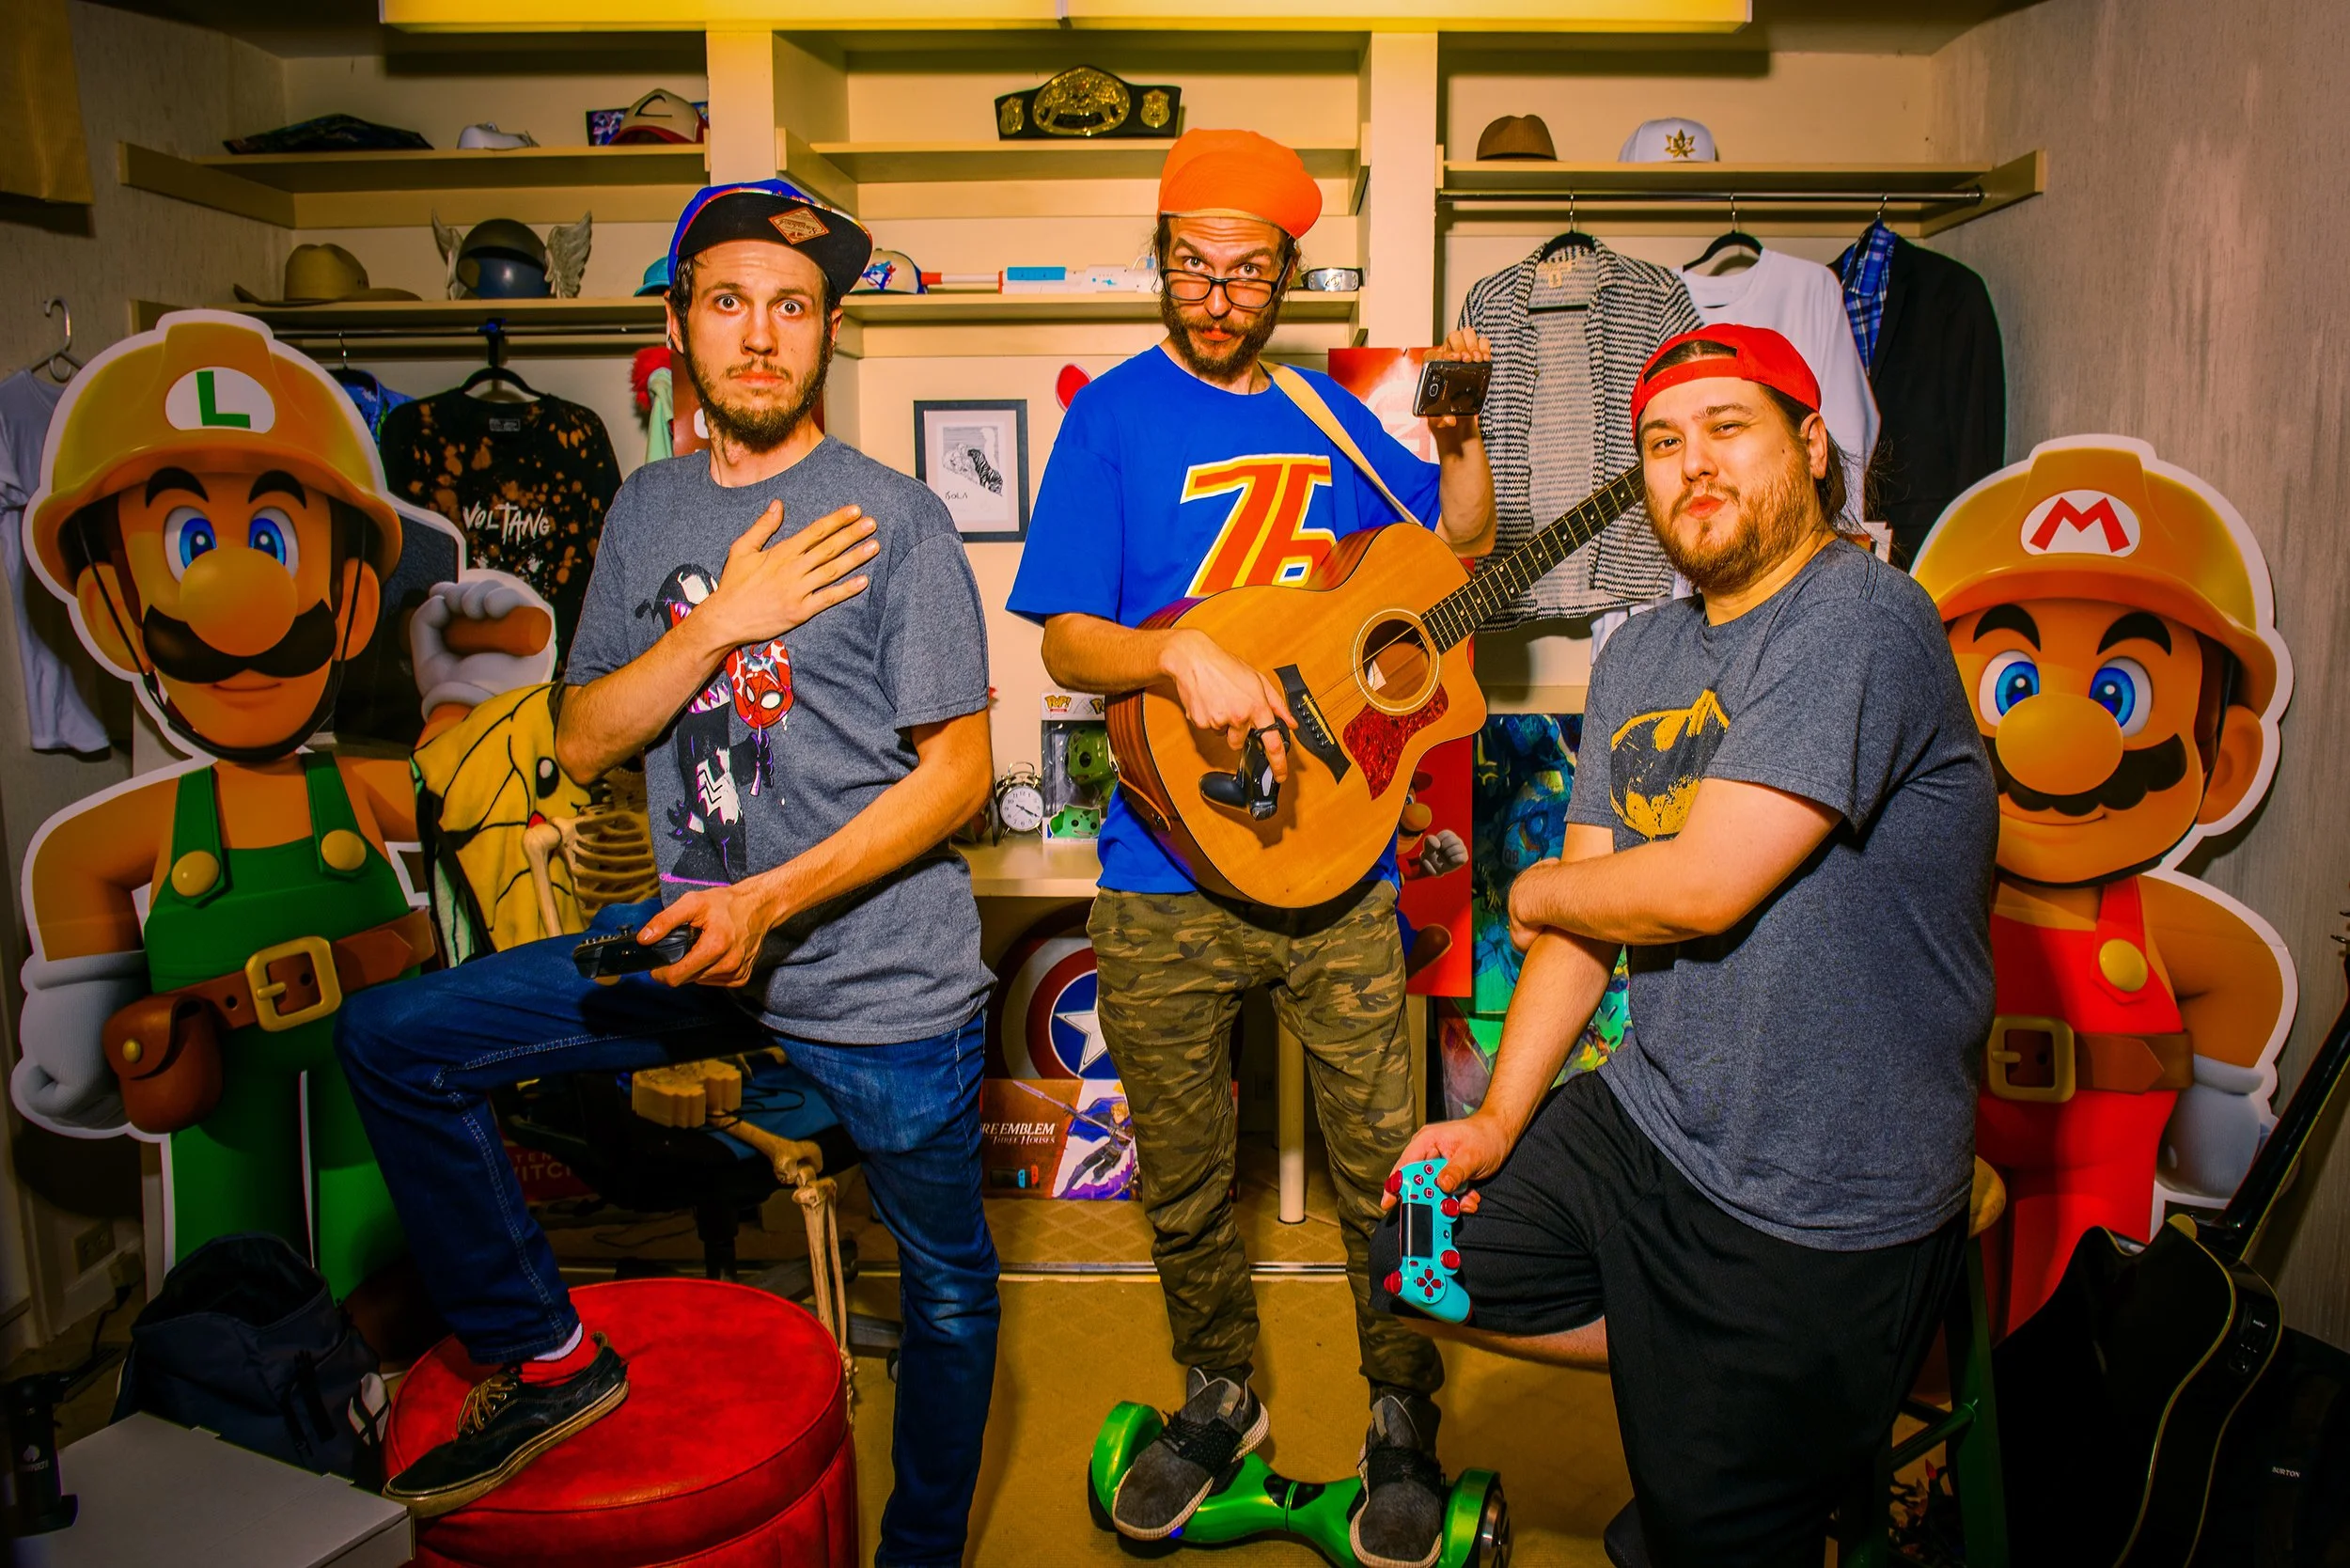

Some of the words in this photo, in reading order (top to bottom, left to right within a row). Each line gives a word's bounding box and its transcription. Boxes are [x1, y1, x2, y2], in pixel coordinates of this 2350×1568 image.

[196, 370, 251, 430] L
[462, 500, 551, 545] VOLTANG
[1180, 453, 1337, 598] 76
[2029, 496, 2131, 554] M
[1000, 1122, 1056, 1136] EMBLEM
